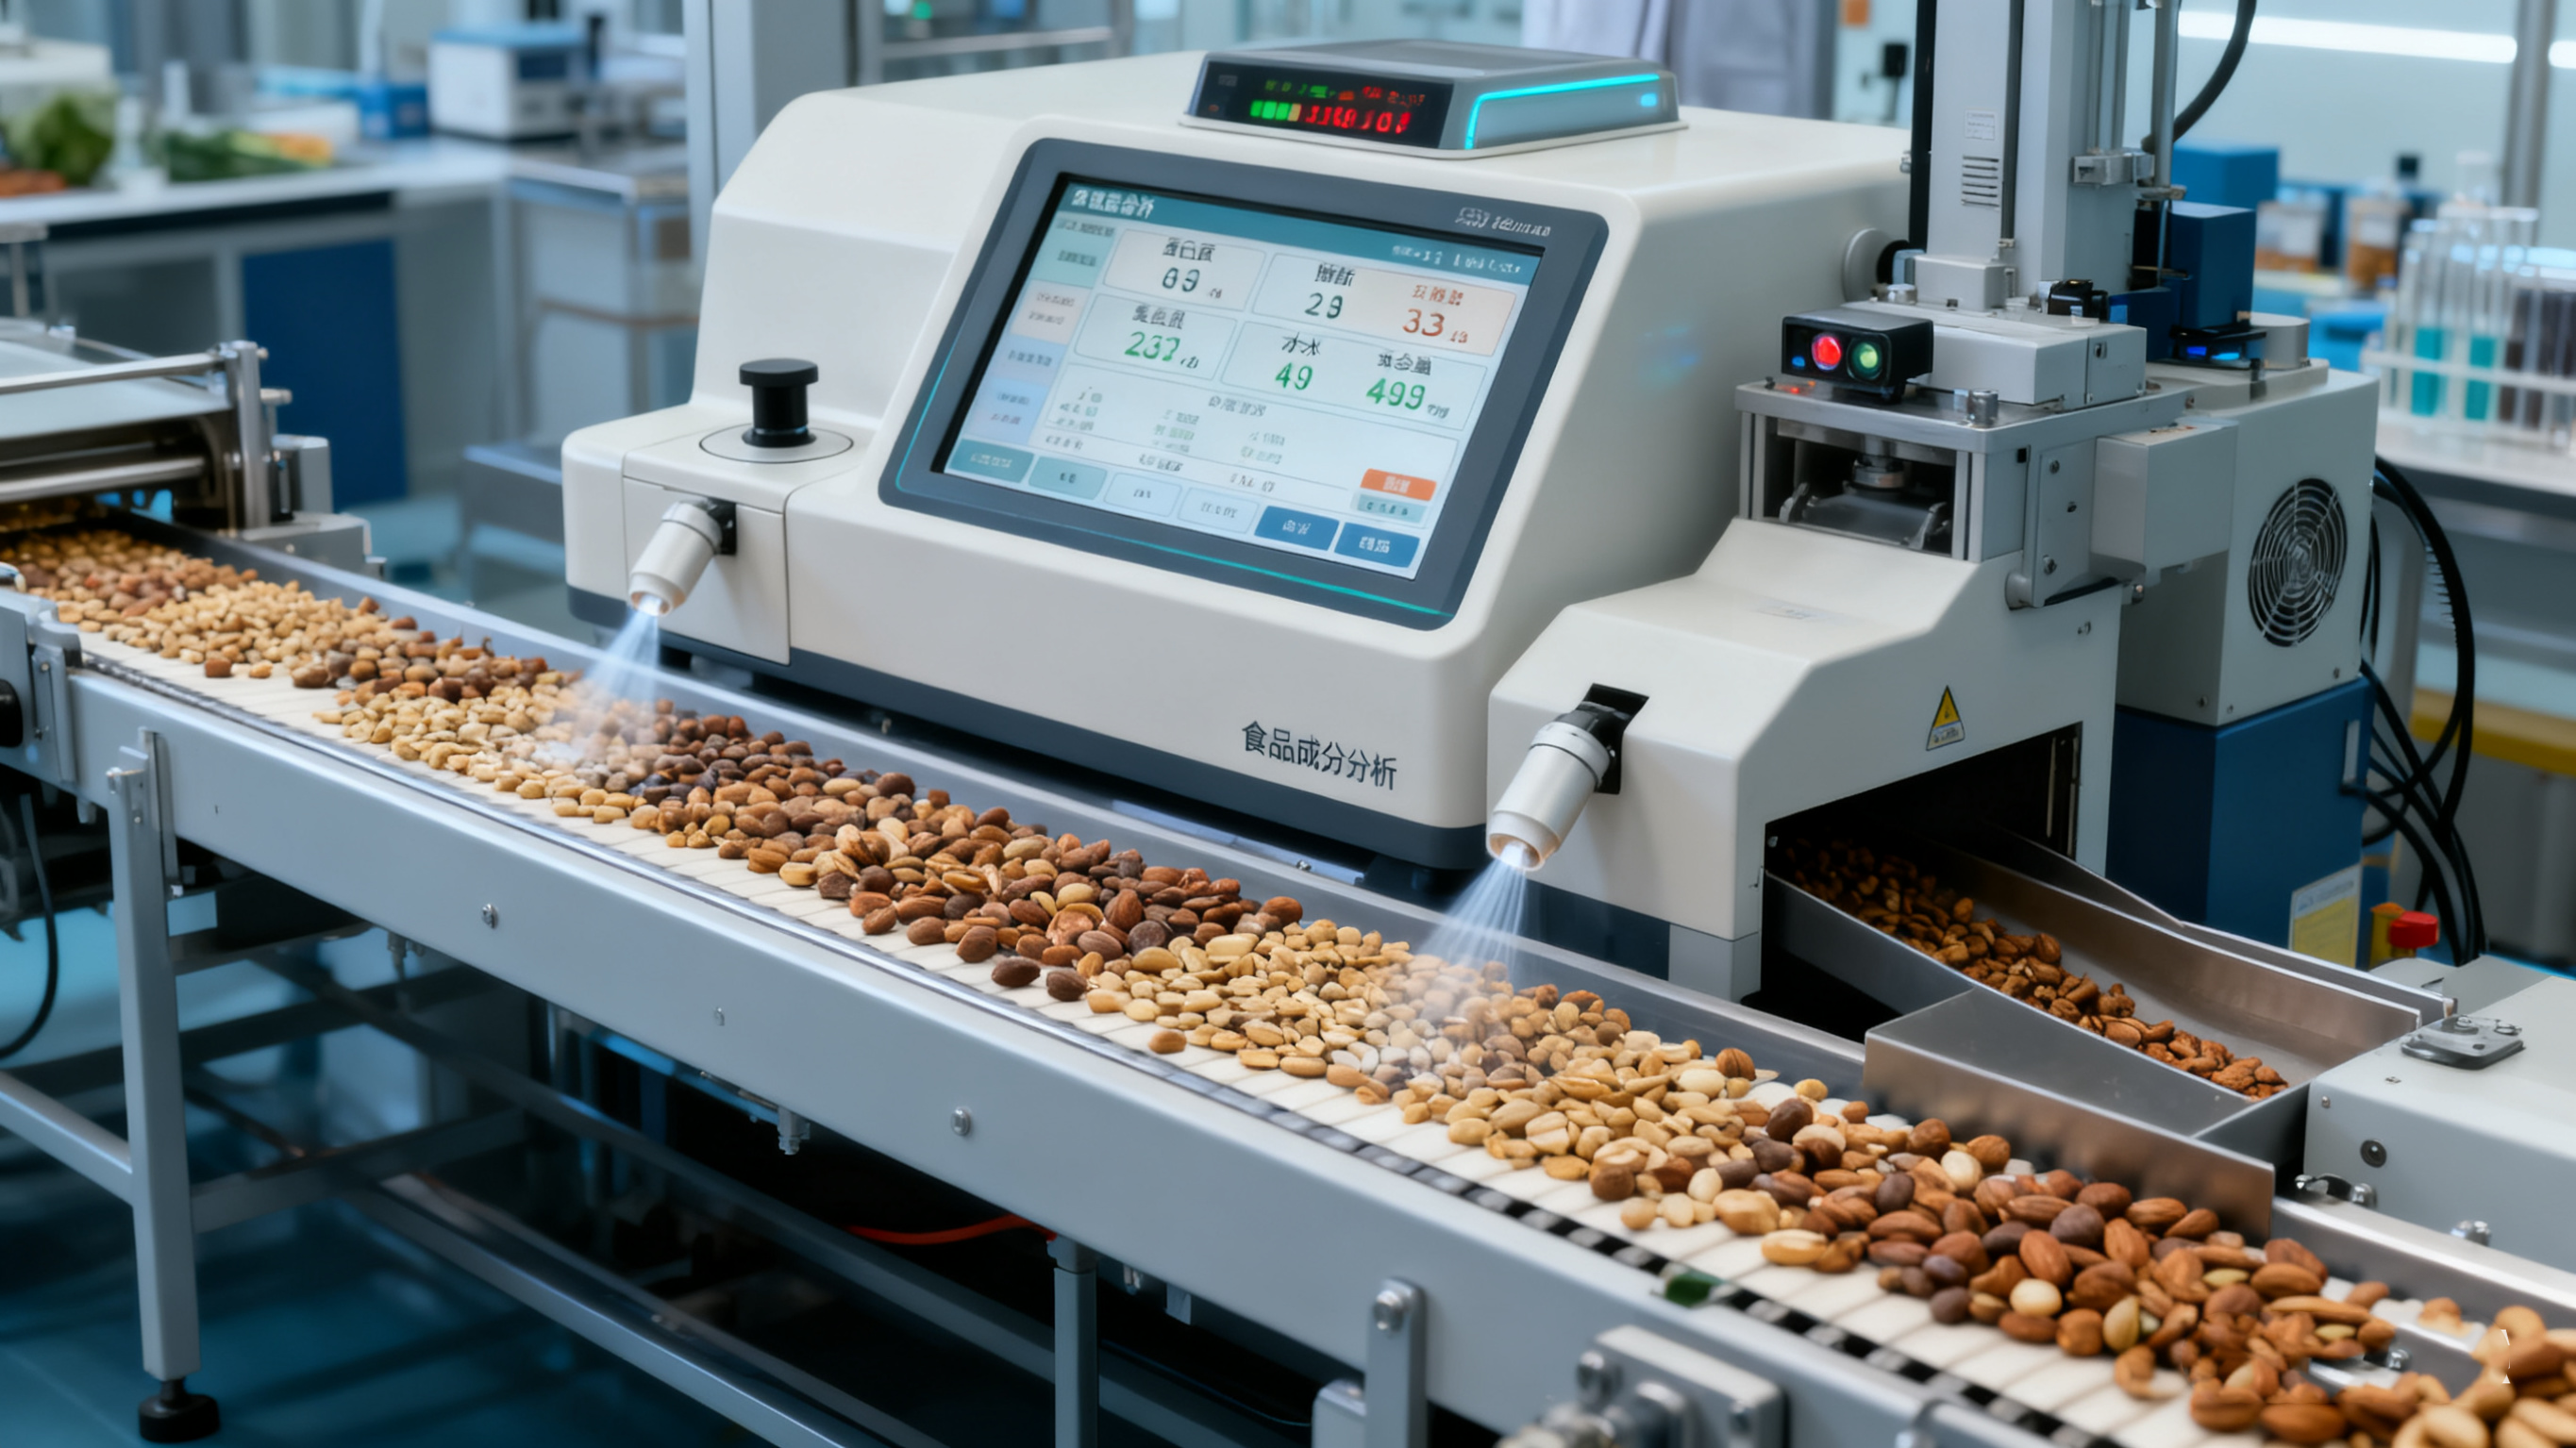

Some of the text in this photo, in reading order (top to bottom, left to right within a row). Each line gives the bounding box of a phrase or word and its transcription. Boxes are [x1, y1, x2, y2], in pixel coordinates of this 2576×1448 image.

[1304, 292, 1343, 320] 29
[1402, 308, 1445, 337] 33
[1275, 362, 1313, 391] 49
[1366, 377, 1426, 410] 499
[1242, 721, 1397, 791] 食品成分分析
